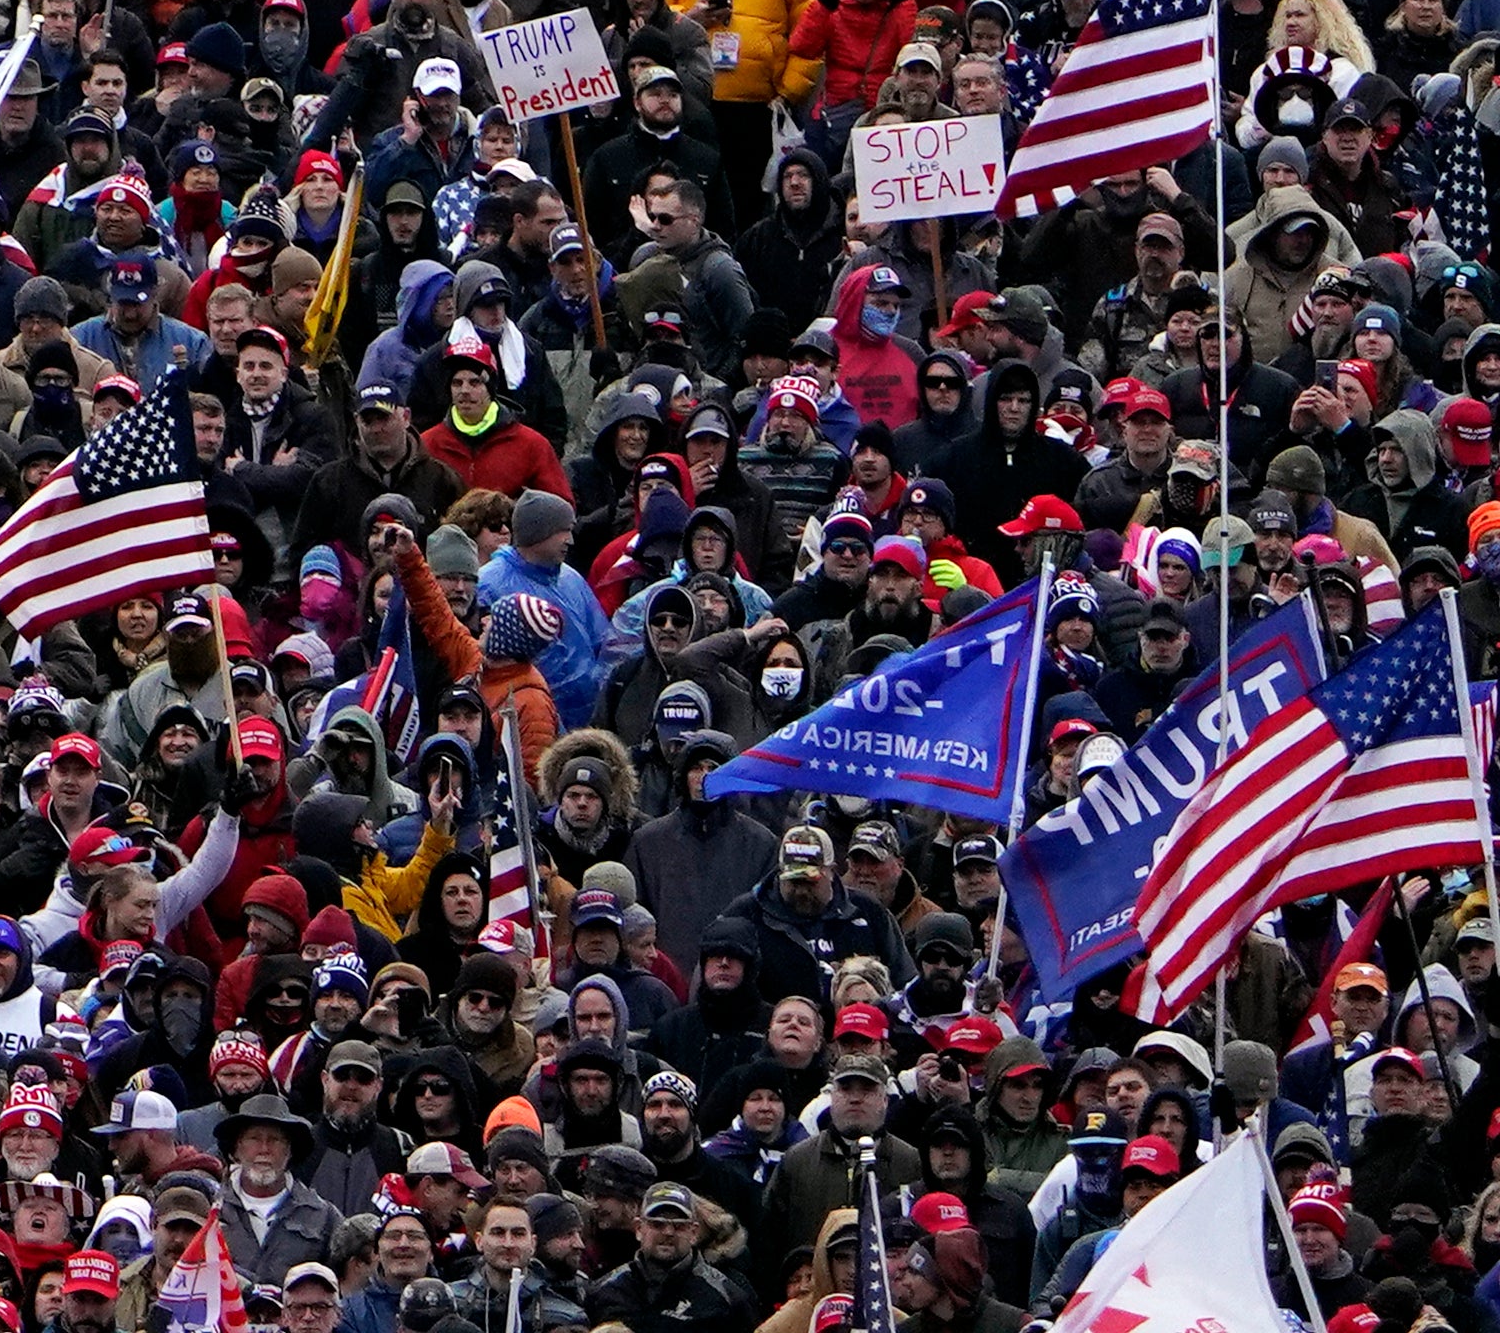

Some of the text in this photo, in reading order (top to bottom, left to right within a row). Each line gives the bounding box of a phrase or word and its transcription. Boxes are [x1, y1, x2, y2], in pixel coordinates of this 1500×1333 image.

[488, 15, 575, 70] TRUMP
[502, 64, 620, 122] President
[532, 61, 547, 80] IS
[866, 122, 968, 164] STOP
[870, 163, 997, 211] STEAL!
[905, 161, 940, 177] the
